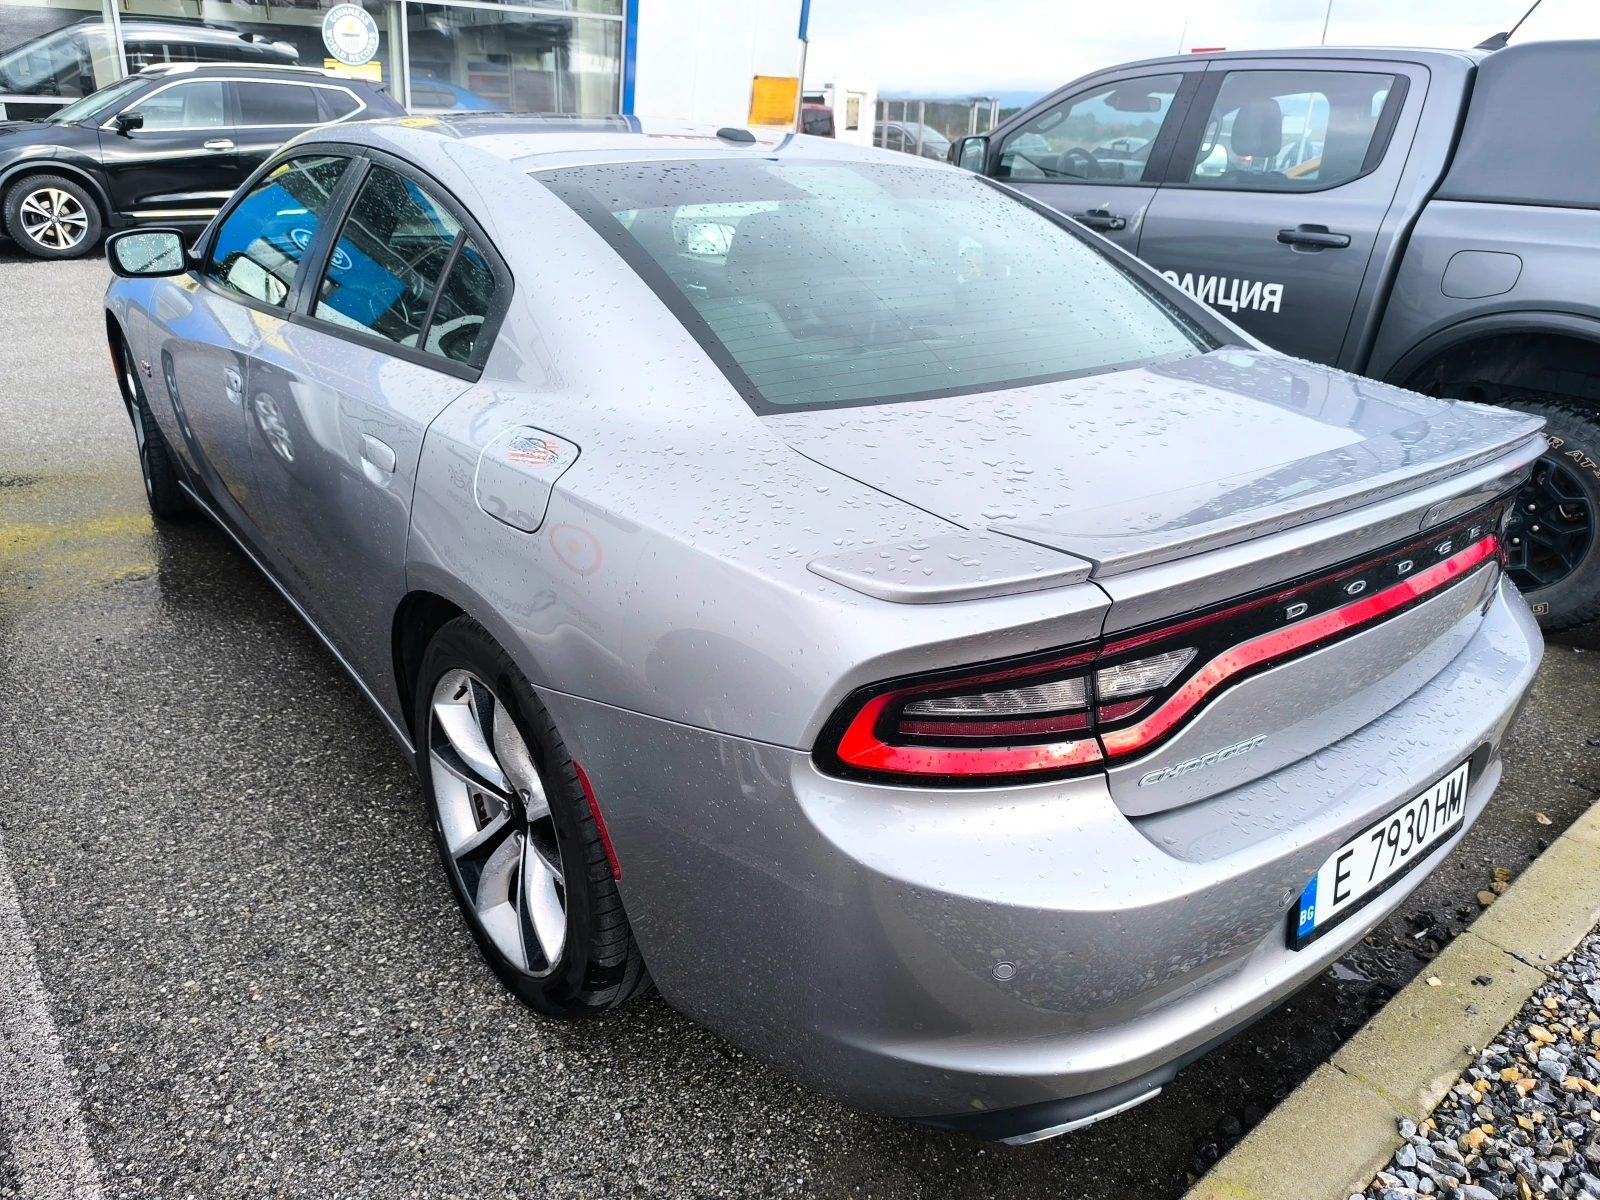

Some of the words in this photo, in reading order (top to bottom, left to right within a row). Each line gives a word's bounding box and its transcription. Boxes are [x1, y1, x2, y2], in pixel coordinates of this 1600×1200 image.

[329, 7, 371, 26] GUINNESS
[325, 29, 347, 59] WORLD
[348, 32, 376, 62] RECORDS
[1157, 269, 1284, 313] ОЛИЦИЯ
[1285, 526, 1481, 620] DODGE
[1138, 733, 1267, 787] CHARGER
[1333, 849, 1353, 906] E
[1368, 798, 1430, 882] 7930
[1432, 771, 1465, 833] HM
[1300, 906, 1314, 926] BG
